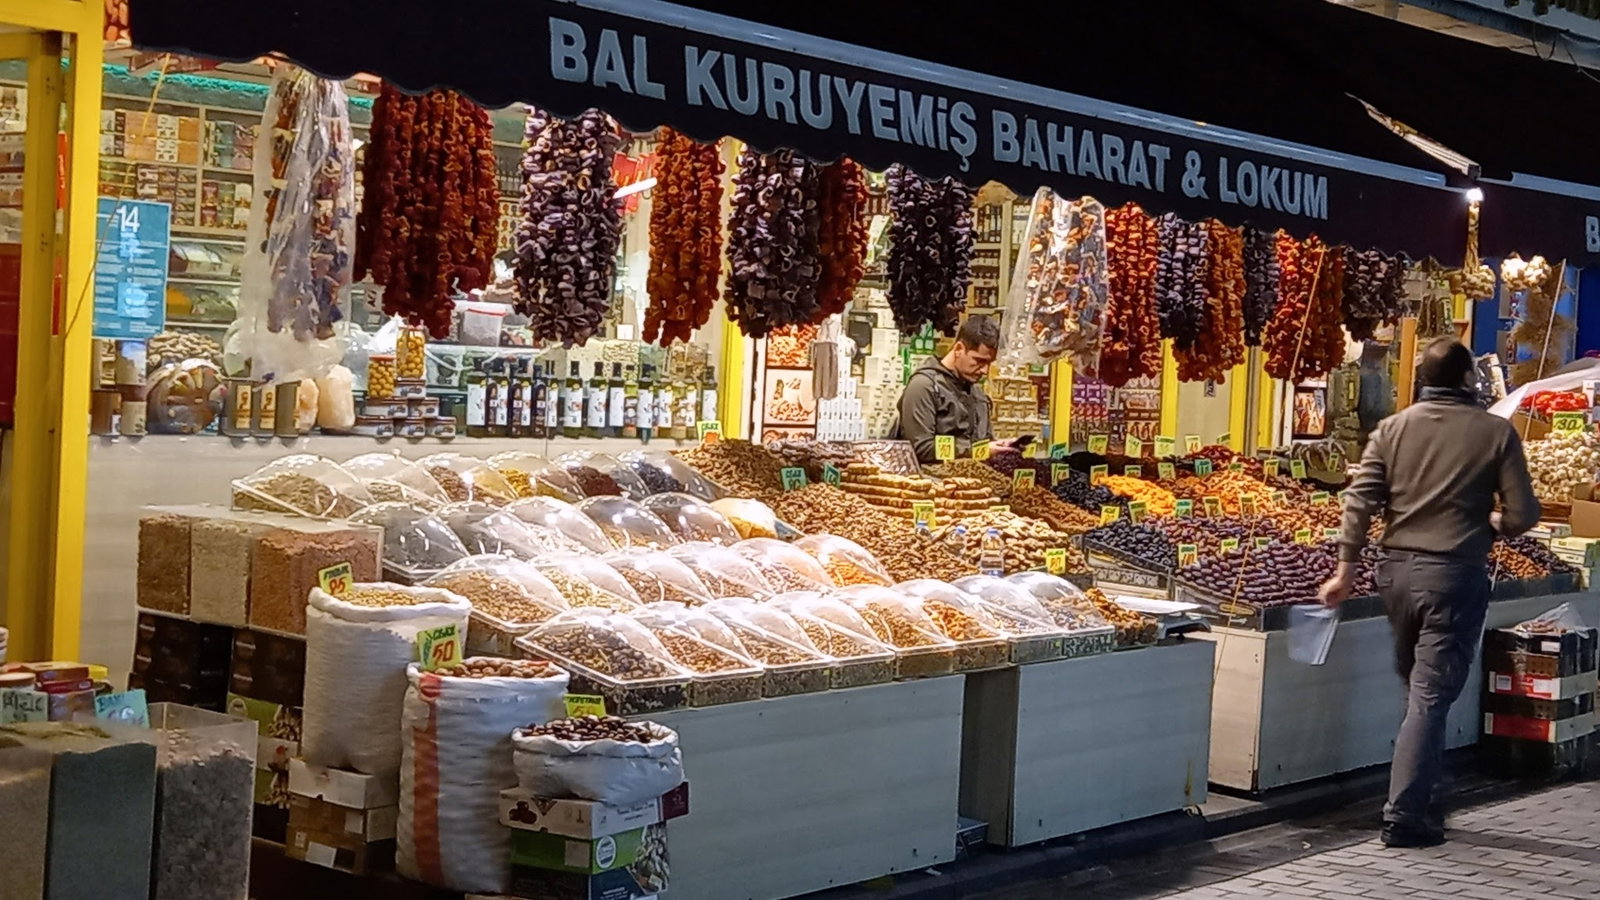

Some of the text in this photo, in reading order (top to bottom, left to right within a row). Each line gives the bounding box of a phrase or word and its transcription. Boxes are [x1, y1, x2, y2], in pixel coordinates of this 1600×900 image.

[549, 17, 665, 100] BAL
[992, 109, 1171, 193] BAHARAT
[1181, 150, 1210, 200] &
[1219, 157, 1329, 221] LOKUM
[116, 205, 140, 233] 14
